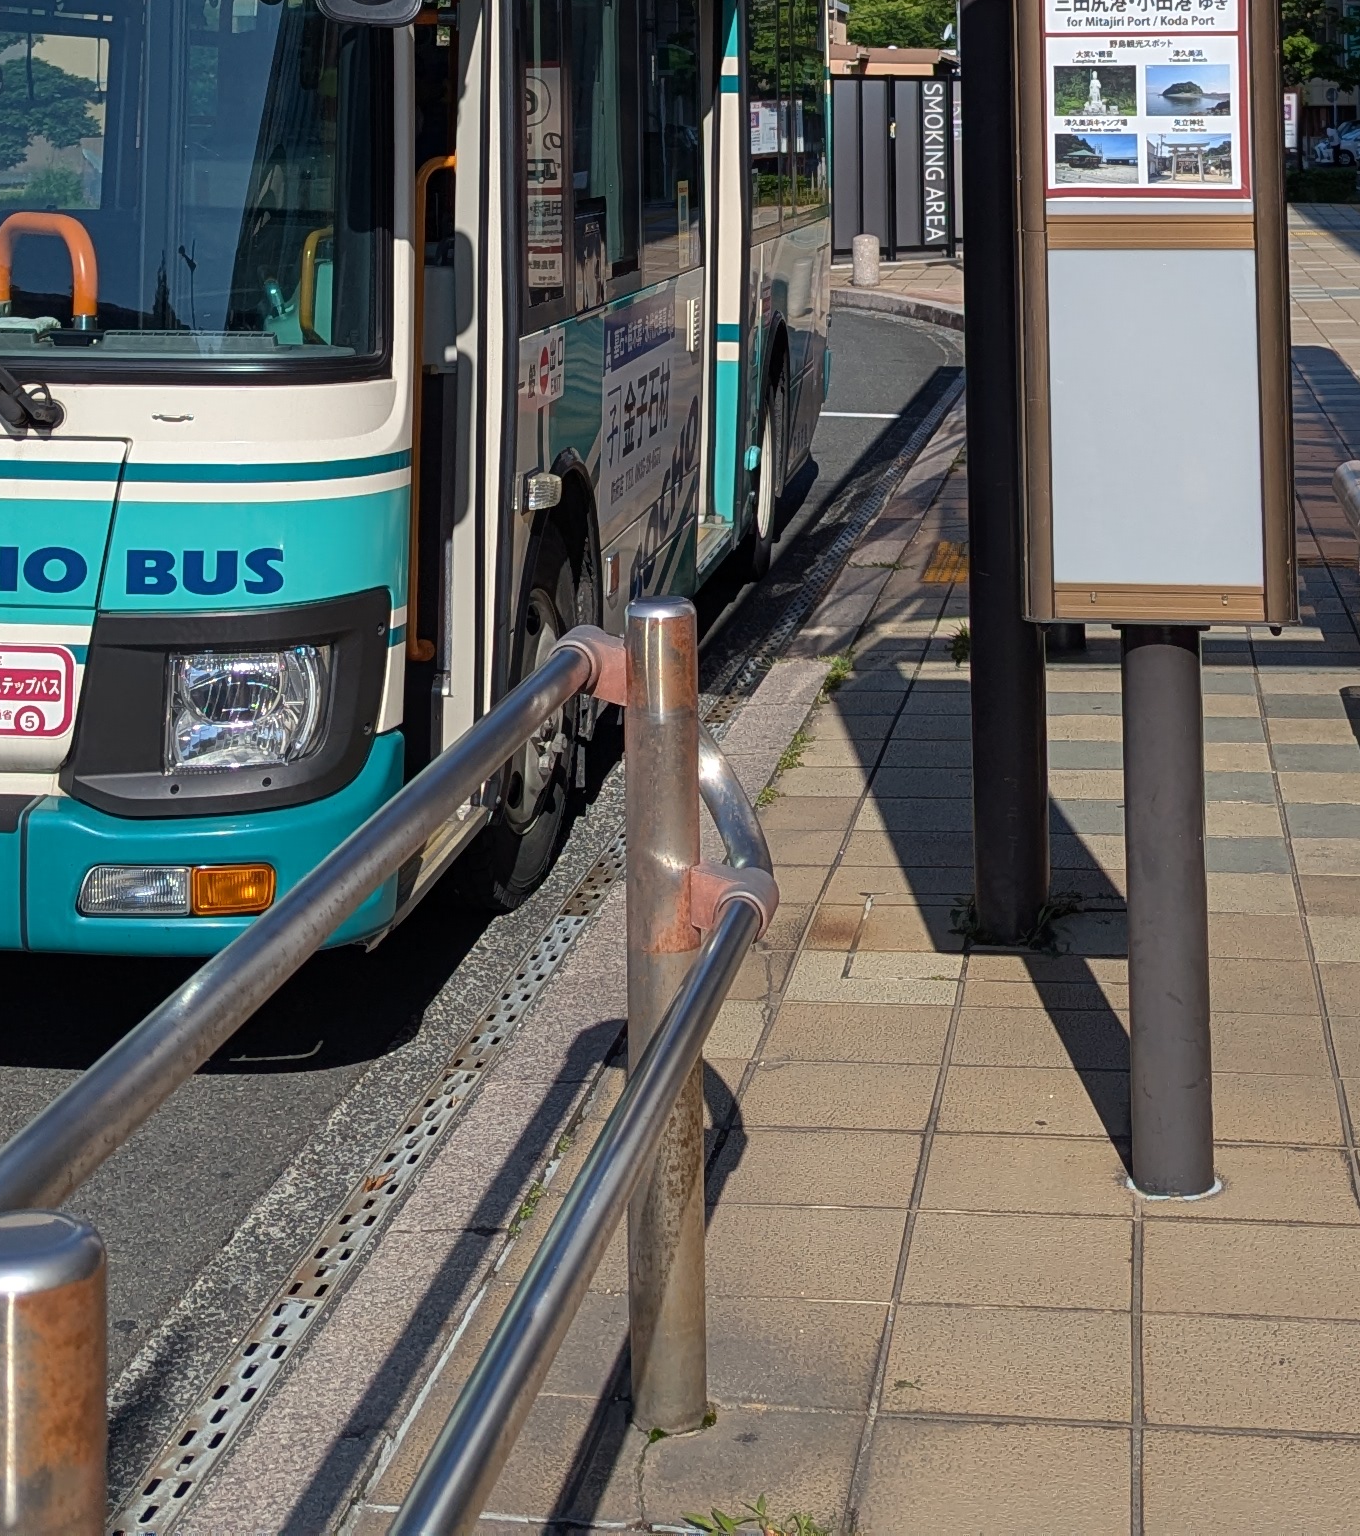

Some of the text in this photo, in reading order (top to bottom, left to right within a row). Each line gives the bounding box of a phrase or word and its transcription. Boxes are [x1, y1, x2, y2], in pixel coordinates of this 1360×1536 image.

[1066, 16, 1083, 27] for
[1084, 15, 1125, 30] Mitajiri
[1126, 15, 1151, 27] Port
[1160, 15, 1189, 27] Koda
[1191, 15, 1216, 27] Port
[923, 83, 946, 242] SMOKING AREA
[549, 335, 564, 371] 出口
[622, 358, 671, 457] 金子石材
[125, 546, 286, 596] BUS
